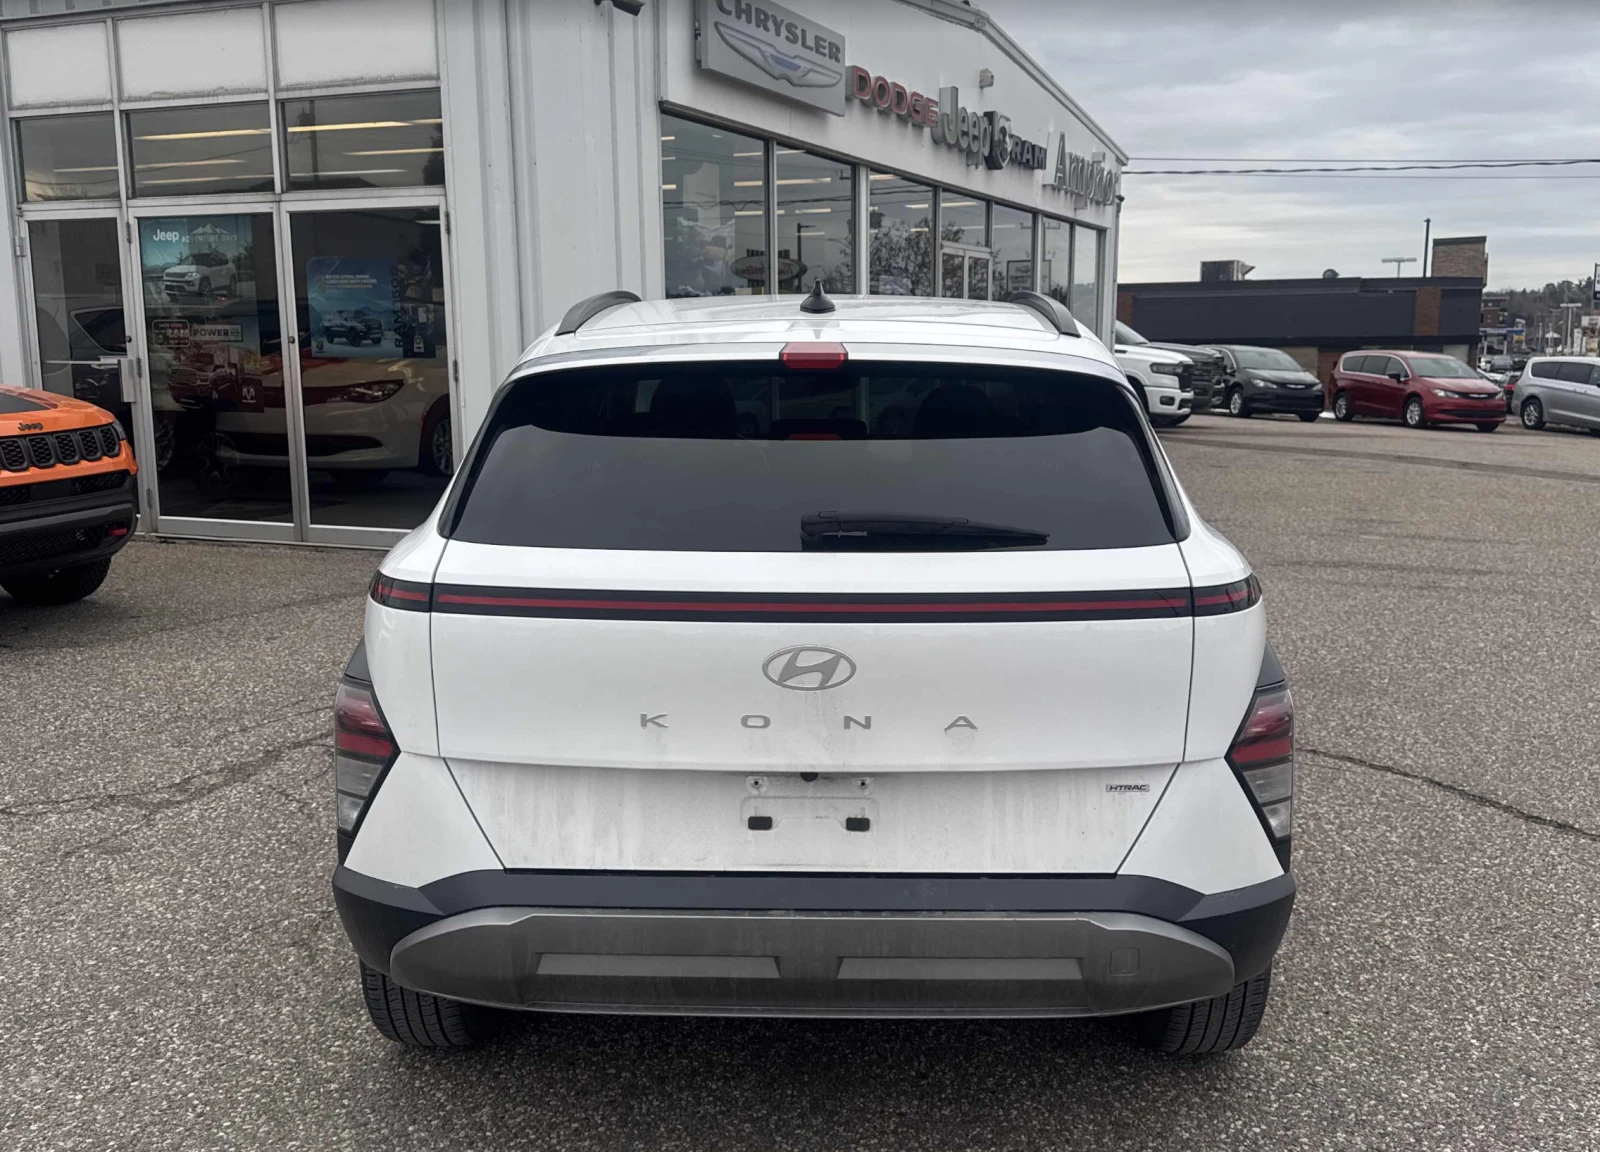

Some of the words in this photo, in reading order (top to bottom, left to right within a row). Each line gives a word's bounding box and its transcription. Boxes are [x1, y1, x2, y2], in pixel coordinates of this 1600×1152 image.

[852, 65, 939, 127] DODGE
[938, 86, 993, 166] Jeep
[1012, 134, 1047, 169] RAM
[153, 229, 180, 243] Jeep
[193, 328, 229, 337] POWER
[18, 422, 43, 431] Jeep
